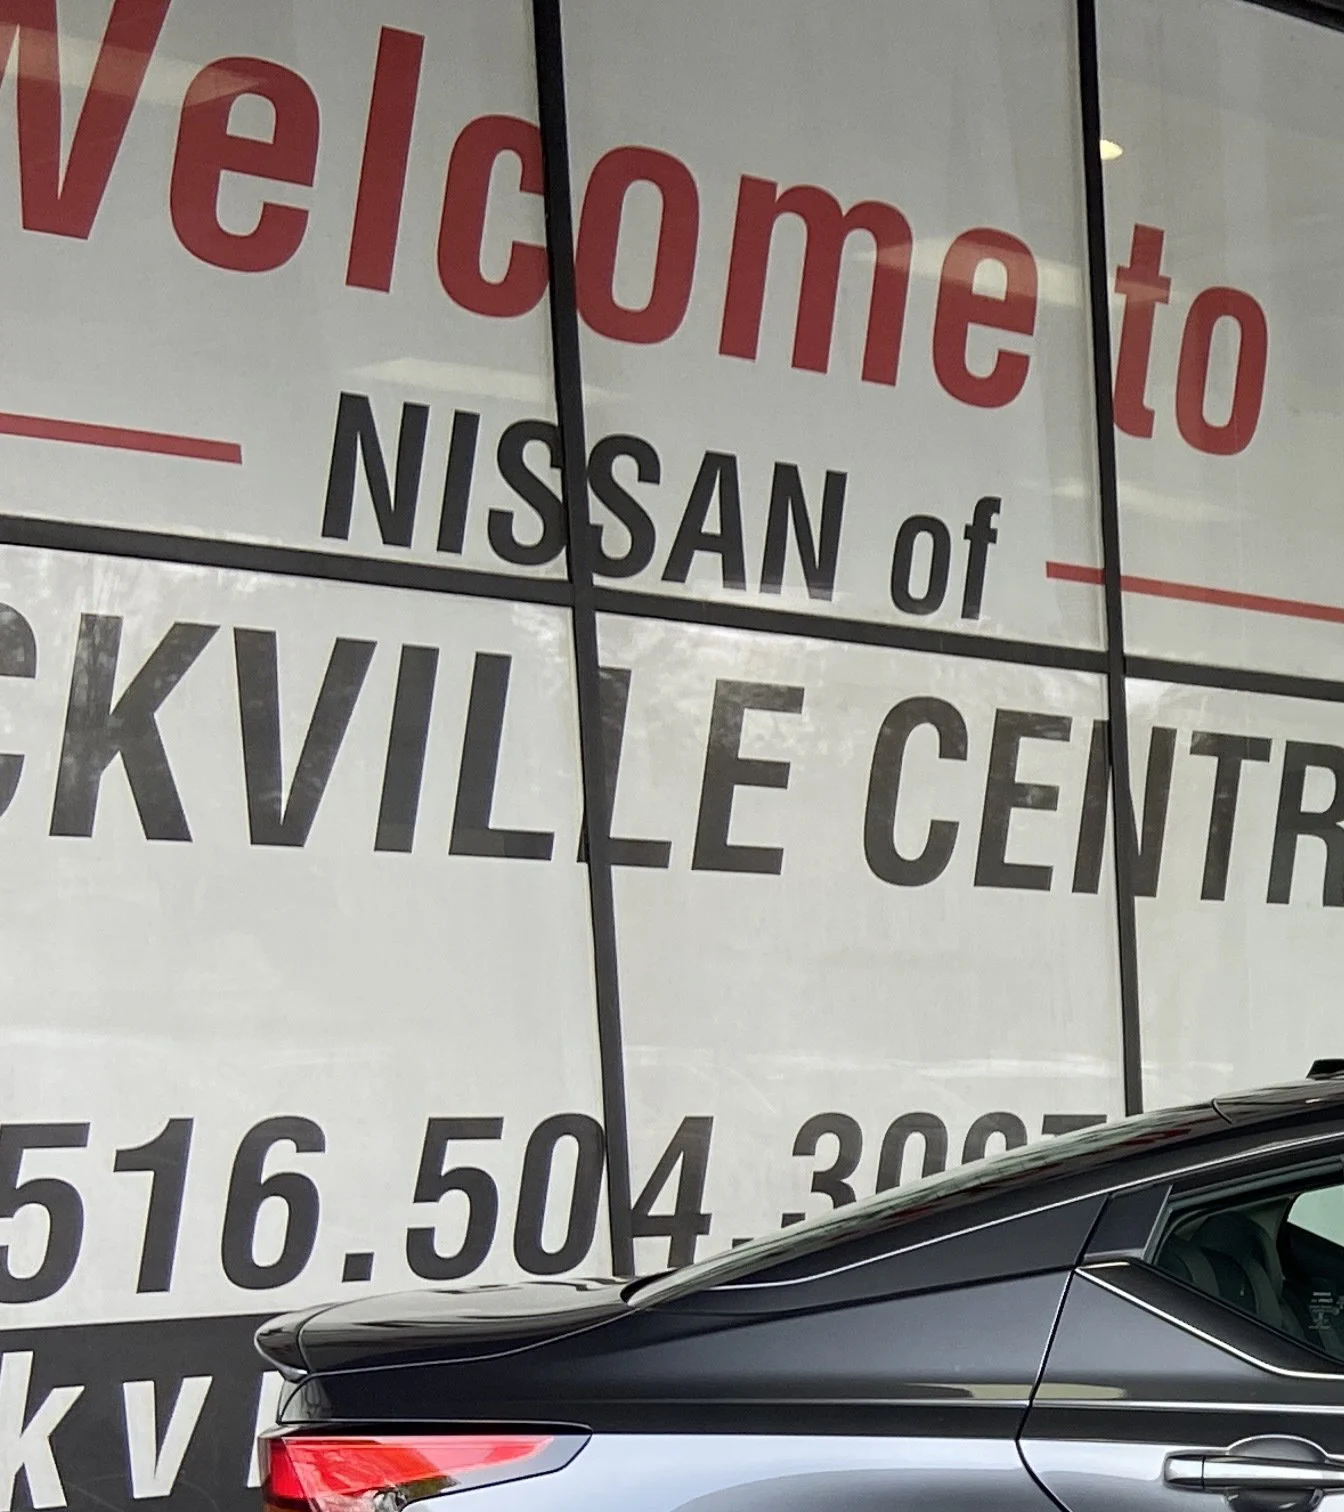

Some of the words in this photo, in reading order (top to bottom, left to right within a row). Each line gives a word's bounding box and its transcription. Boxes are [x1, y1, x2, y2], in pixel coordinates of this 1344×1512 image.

[1111, 223, 1268, 456] to
[321, 392, 847, 602] NISSAN
[890, 496, 1001, 621] of
